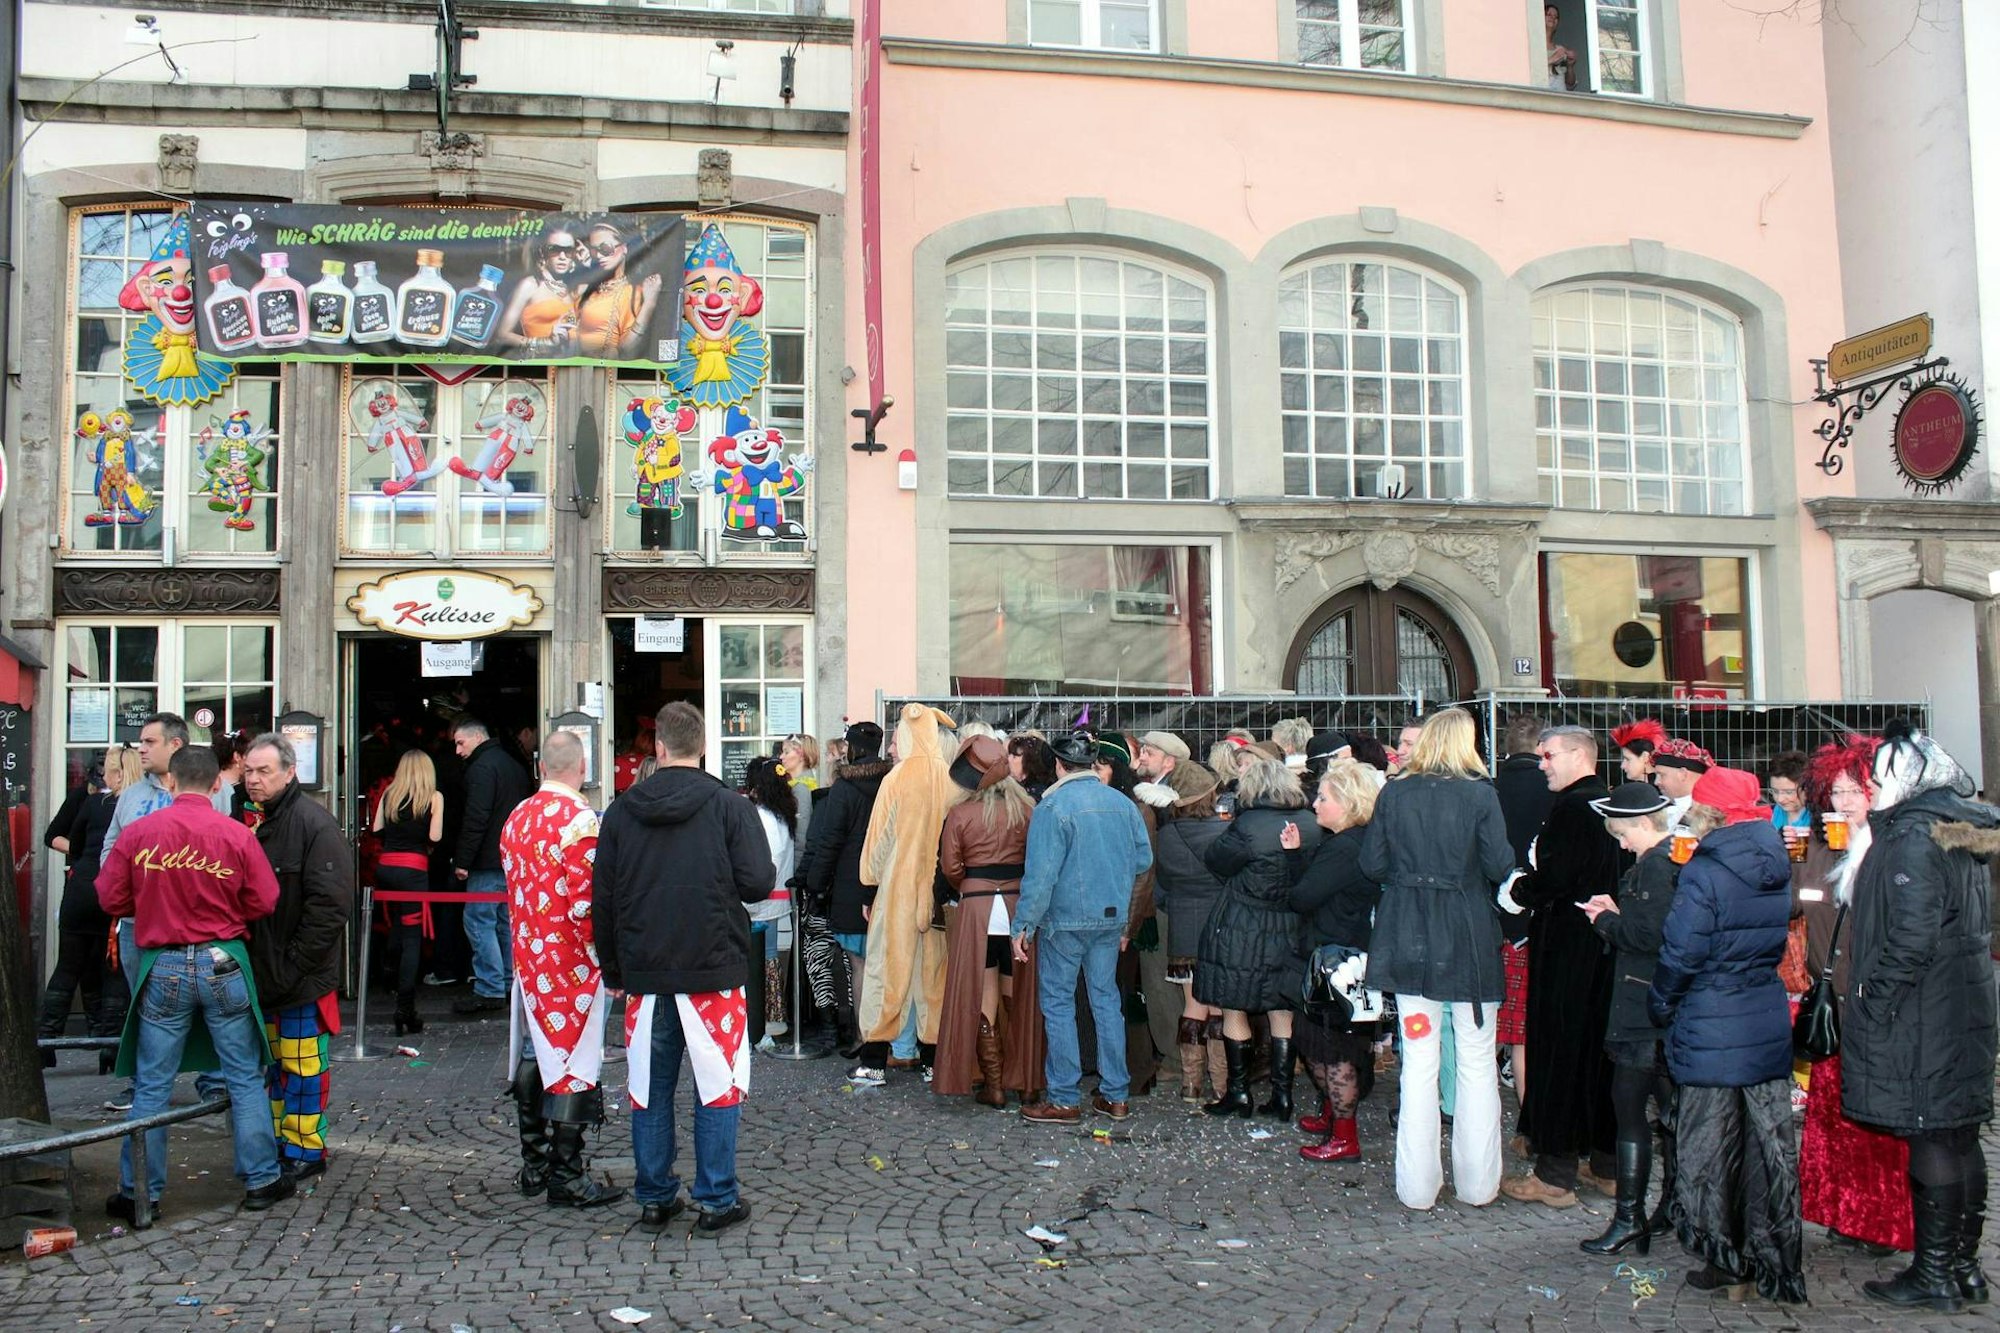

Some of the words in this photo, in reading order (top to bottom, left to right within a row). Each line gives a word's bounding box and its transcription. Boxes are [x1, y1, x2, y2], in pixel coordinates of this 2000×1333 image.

[276, 228, 308, 246] Wie
[309, 217, 396, 246] SCHRÄG
[398, 224, 437, 241] sind
[437, 219, 470, 240] die
[472, 218, 544, 239] denn!?!?
[266, 312, 294, 328] Bubble
[271, 322, 289, 335] Gum
[1840, 332, 1919, 367] Antiquitäten
[392, 601, 496, 627] Kulisse
[637, 632, 683, 647] Eingang
[425, 657, 472, 671] Ausgang
[1516, 659, 1530, 673] 12
[127, 718, 146, 727] Gäst
[134, 844, 235, 880] Kulisse
